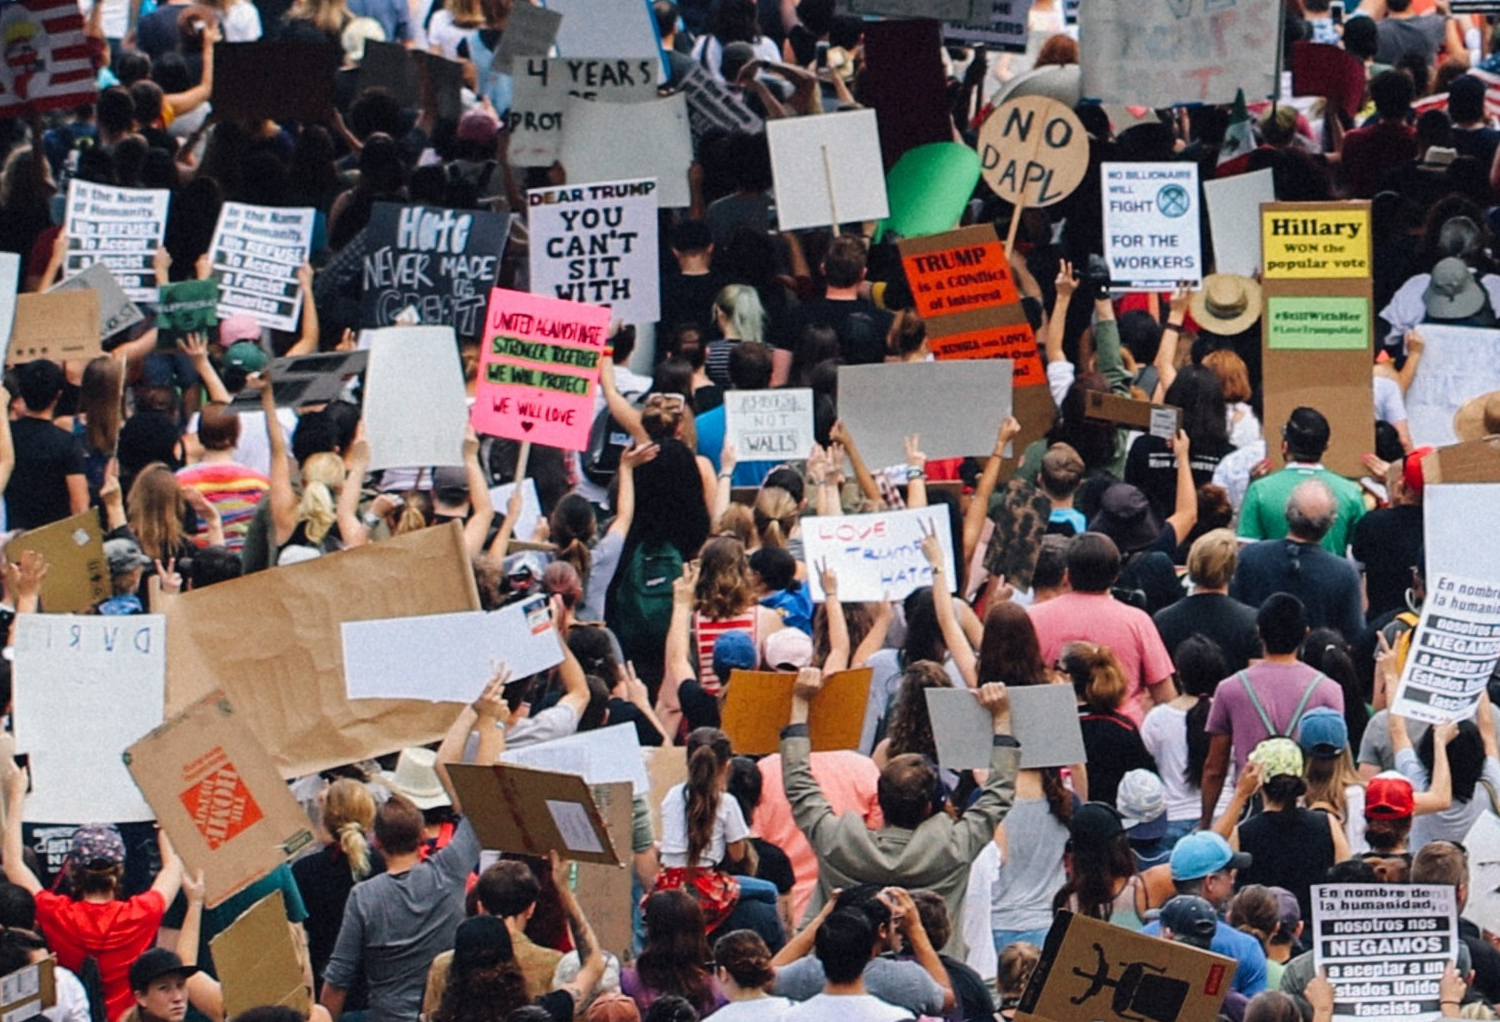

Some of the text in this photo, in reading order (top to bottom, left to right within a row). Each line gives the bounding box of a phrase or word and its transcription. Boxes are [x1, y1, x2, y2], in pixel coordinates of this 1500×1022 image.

[527, 59, 651, 86] 4 YEARS
[1003, 108, 1073, 149] NO
[981, 144, 1062, 203] DAPL
[529, 182, 655, 206] DEAR TRUMP
[397, 207, 472, 253] Hate
[560, 207, 623, 231] YOU
[1272, 218, 1362, 239] Hillary
[547, 230, 637, 257] CAN'T
[1284, 244, 1345, 253] WON the
[364, 246, 497, 290] NEVER MADE
[568, 257, 620, 279] SIT
[913, 248, 986, 274] TRUMP
[1268, 259, 1365, 271] popular vote
[555, 278, 631, 302] WITH
[746, 435, 796, 450] WALLS
[1318, 887, 1430, 898] En nombre de
[1334, 918, 1437, 932] nosotros nos
[1331, 937, 1442, 955] NEGAMOS
[1355, 1001, 1420, 1016] fascista
